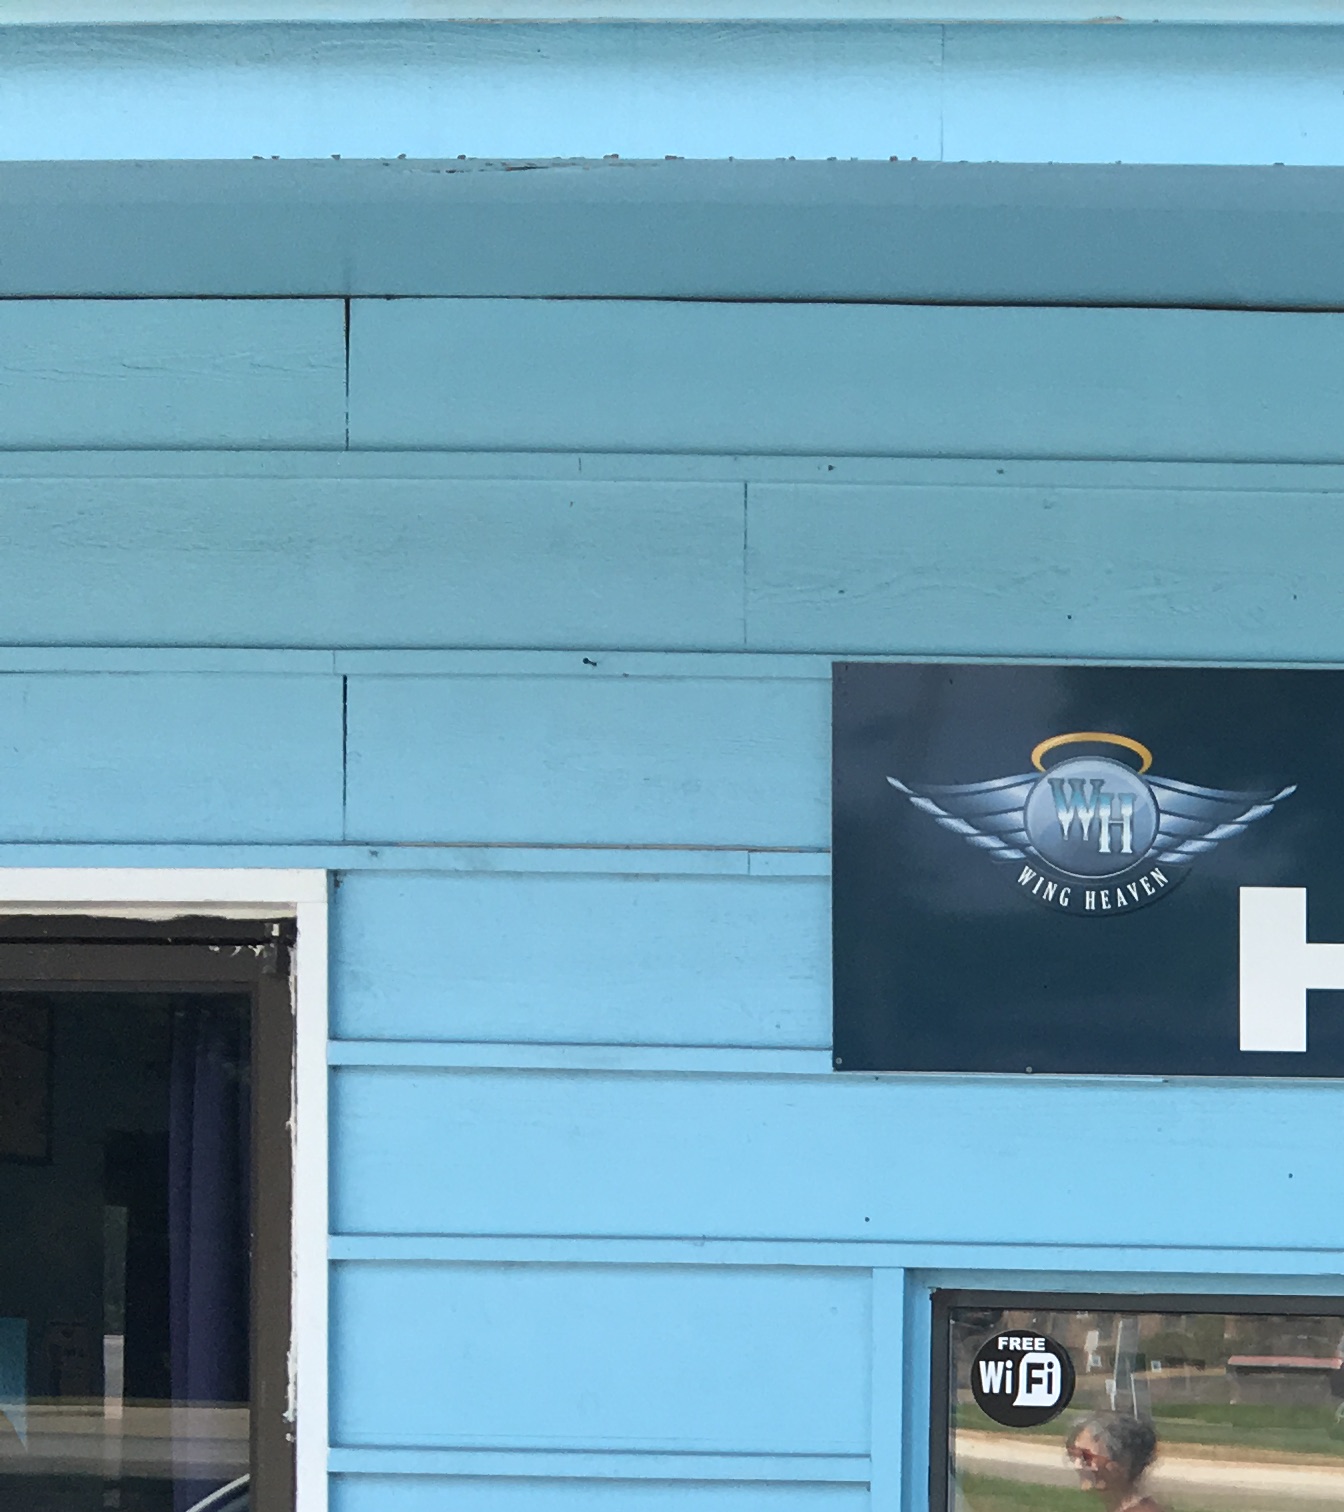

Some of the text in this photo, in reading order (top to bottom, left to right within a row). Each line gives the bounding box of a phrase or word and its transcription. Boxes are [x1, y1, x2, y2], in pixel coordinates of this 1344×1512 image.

[1047, 777, 1137, 854] WH
[1017, 865, 1170, 910] WING HEAVEN
[997, 1336, 1046, 1351] FREE
